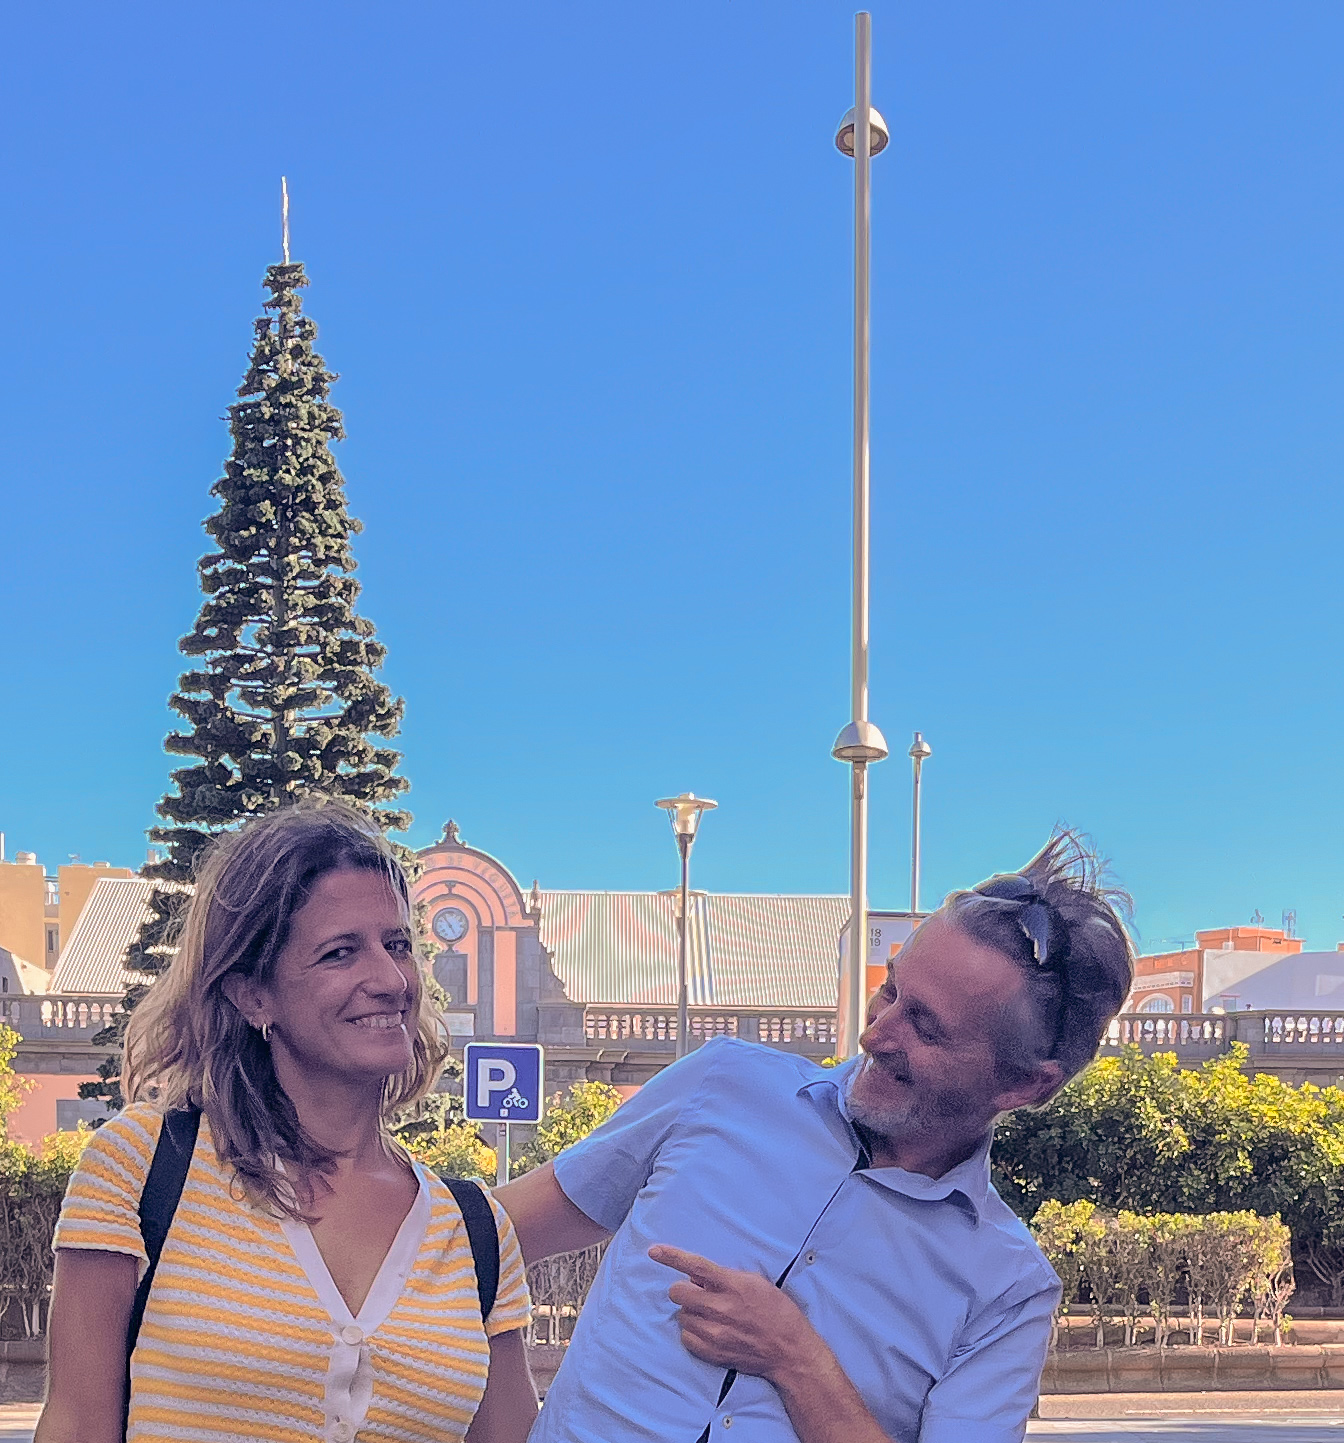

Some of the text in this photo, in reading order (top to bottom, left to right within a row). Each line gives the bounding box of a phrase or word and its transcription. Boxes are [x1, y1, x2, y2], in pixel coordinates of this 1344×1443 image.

[870, 928, 882, 938] 18
[869, 938, 881, 947] 19
[477, 1058, 517, 1107] P
